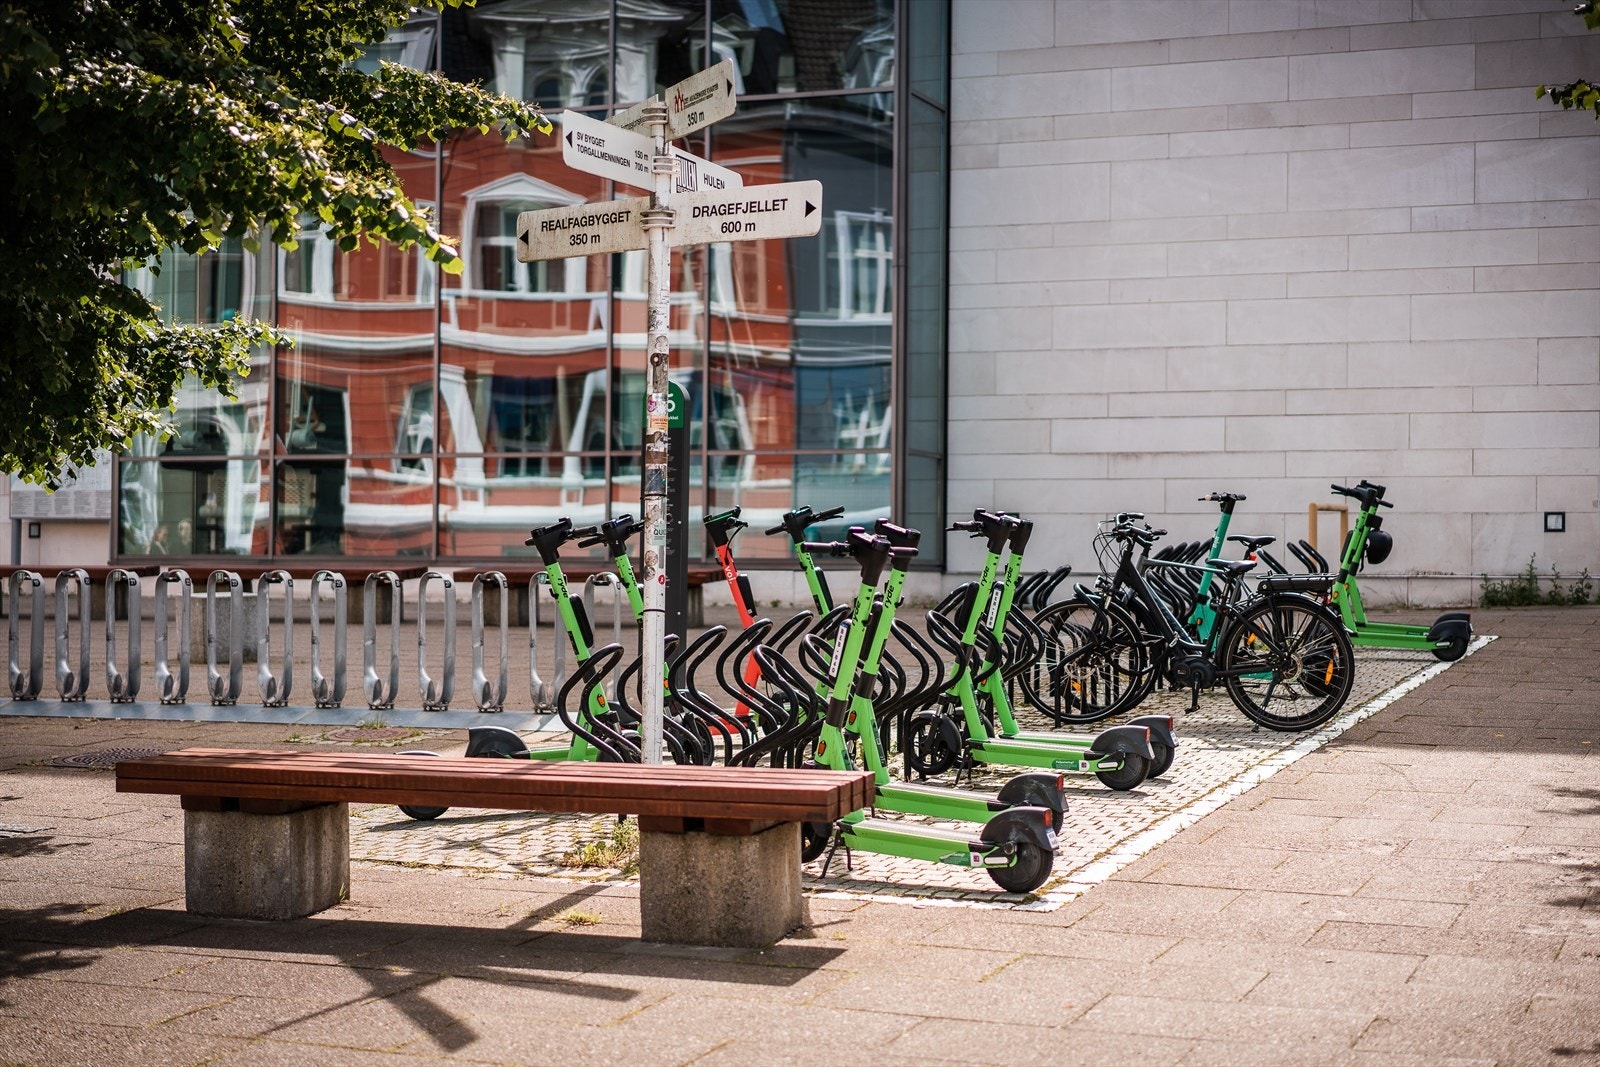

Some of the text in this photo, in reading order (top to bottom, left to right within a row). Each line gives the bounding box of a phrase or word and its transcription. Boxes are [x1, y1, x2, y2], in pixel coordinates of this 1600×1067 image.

[688, 112, 704, 126] 350 m
[577, 132, 605, 148] SV BYGGET
[577, 144, 631, 167] TORGALLMENNINGEN
[635, 150, 643, 159] 150
[635, 162, 643, 171] 700
[704, 173, 725, 189] HULEN
[693, 198, 788, 218] DRAGEFJELLET
[541, 211, 631, 232] REALFAGBYGGET
[721, 221, 756, 233] 600 m
[569, 233, 600, 246] 350 m
[980, 565, 989, 587] ryde
[1005, 566, 1014, 587] ryde
[557, 578, 569, 599] ryde
[885, 585, 895, 608] ryde
[851, 601, 861, 626] ryde
